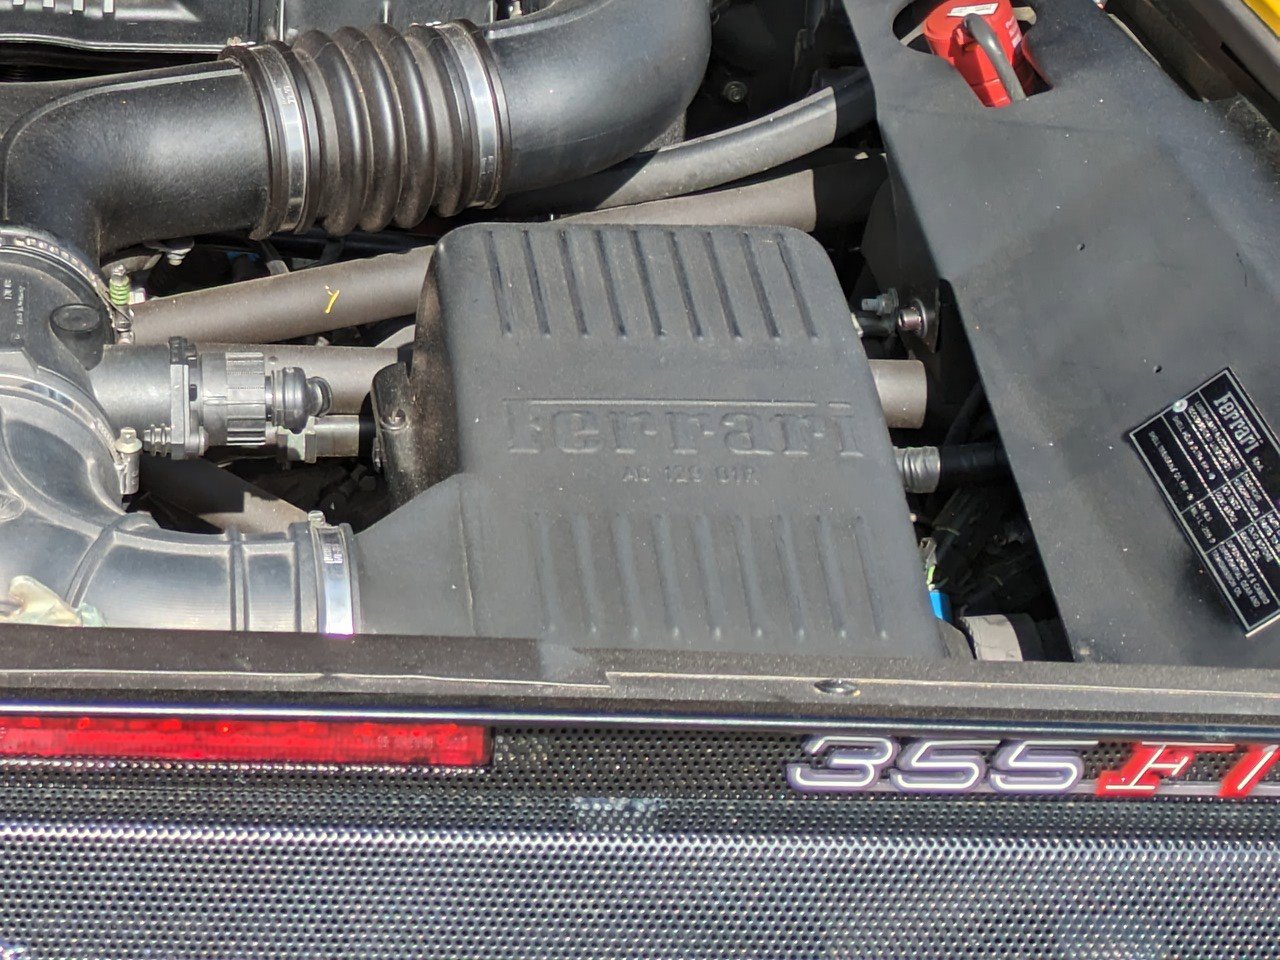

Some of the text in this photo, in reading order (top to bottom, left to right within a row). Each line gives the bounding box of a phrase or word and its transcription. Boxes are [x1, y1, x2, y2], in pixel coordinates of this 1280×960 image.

[503, 398, 865, 458] Ferrari
[1214, 392, 1263, 453] Ferrari
[787, 736, 1280, 797] 355 F1
